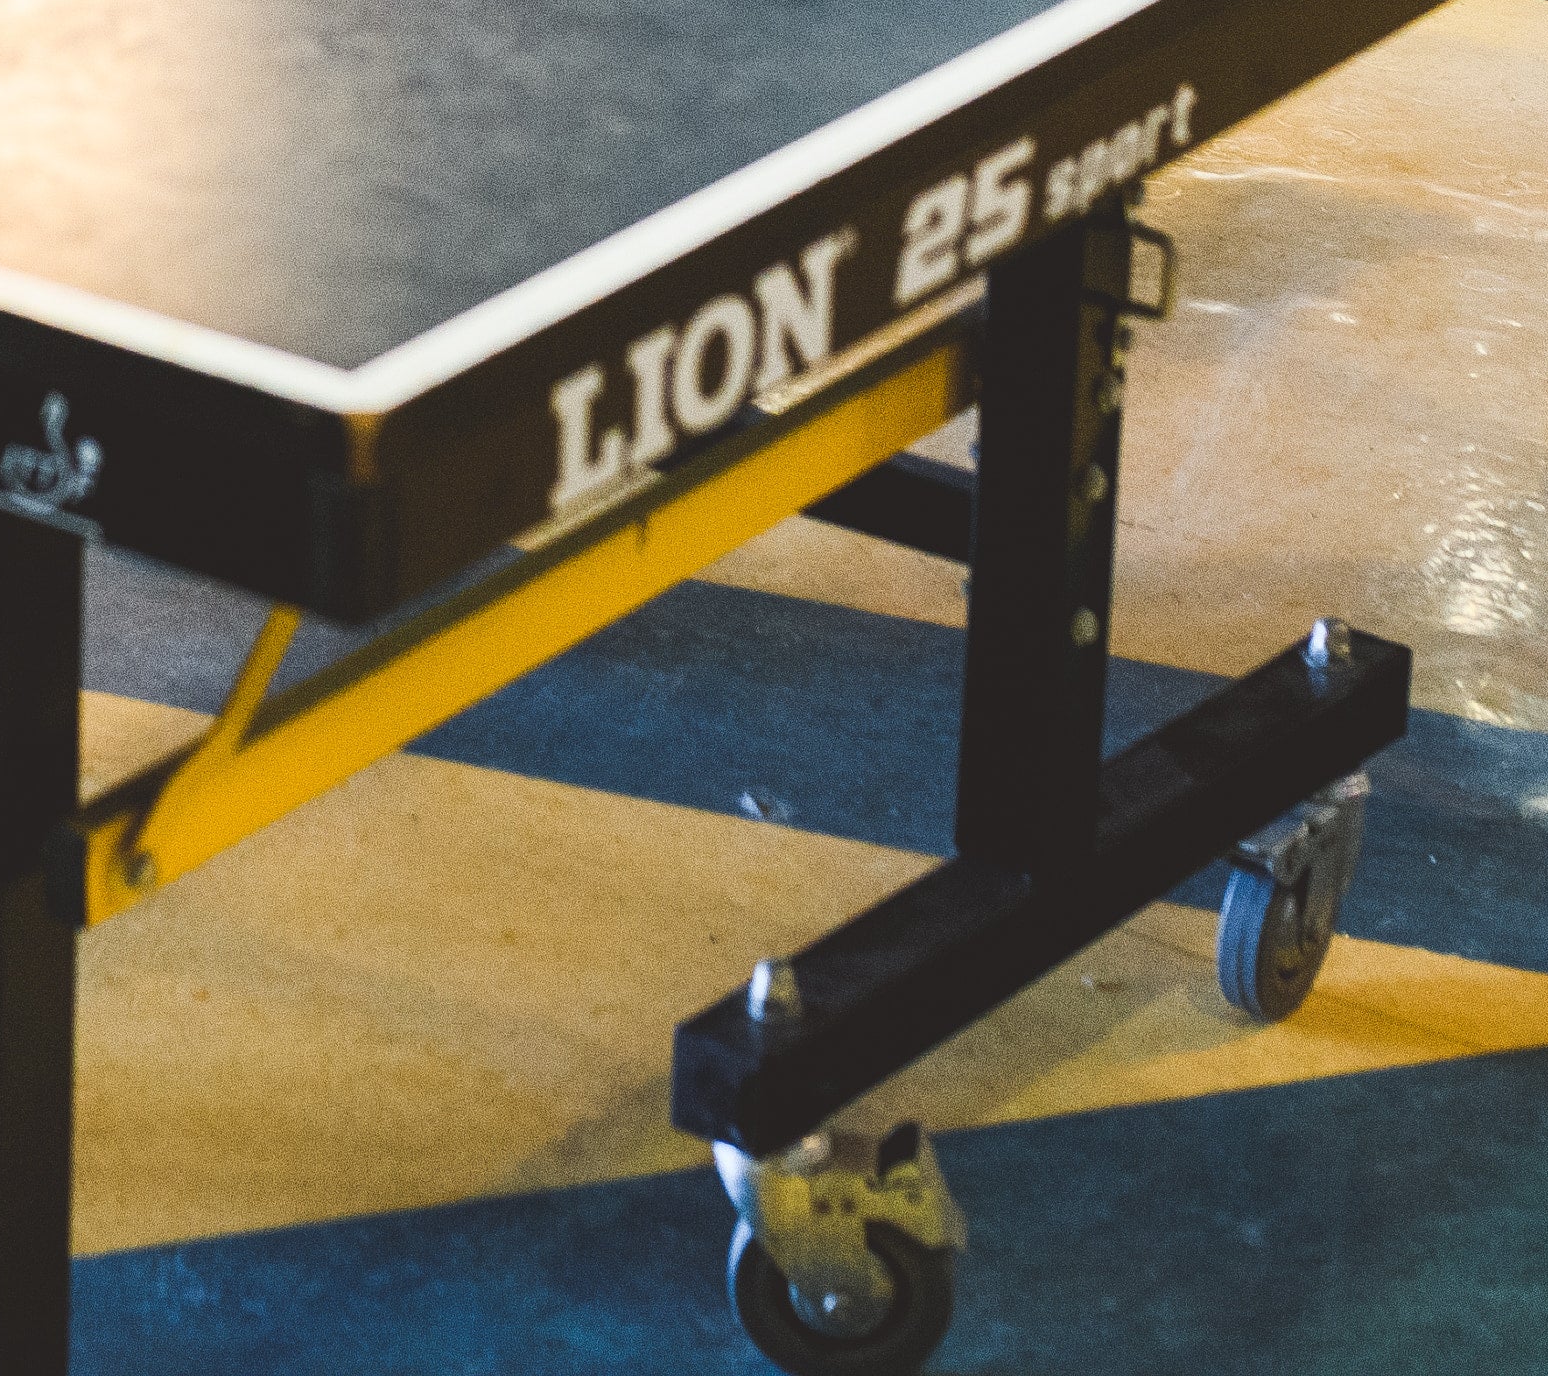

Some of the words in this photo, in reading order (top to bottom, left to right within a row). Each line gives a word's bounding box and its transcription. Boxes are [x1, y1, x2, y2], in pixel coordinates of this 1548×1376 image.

[549, 232, 841, 514] LION
[893, 134, 1038, 305] 25
[1044, 82, 1198, 219] sport
